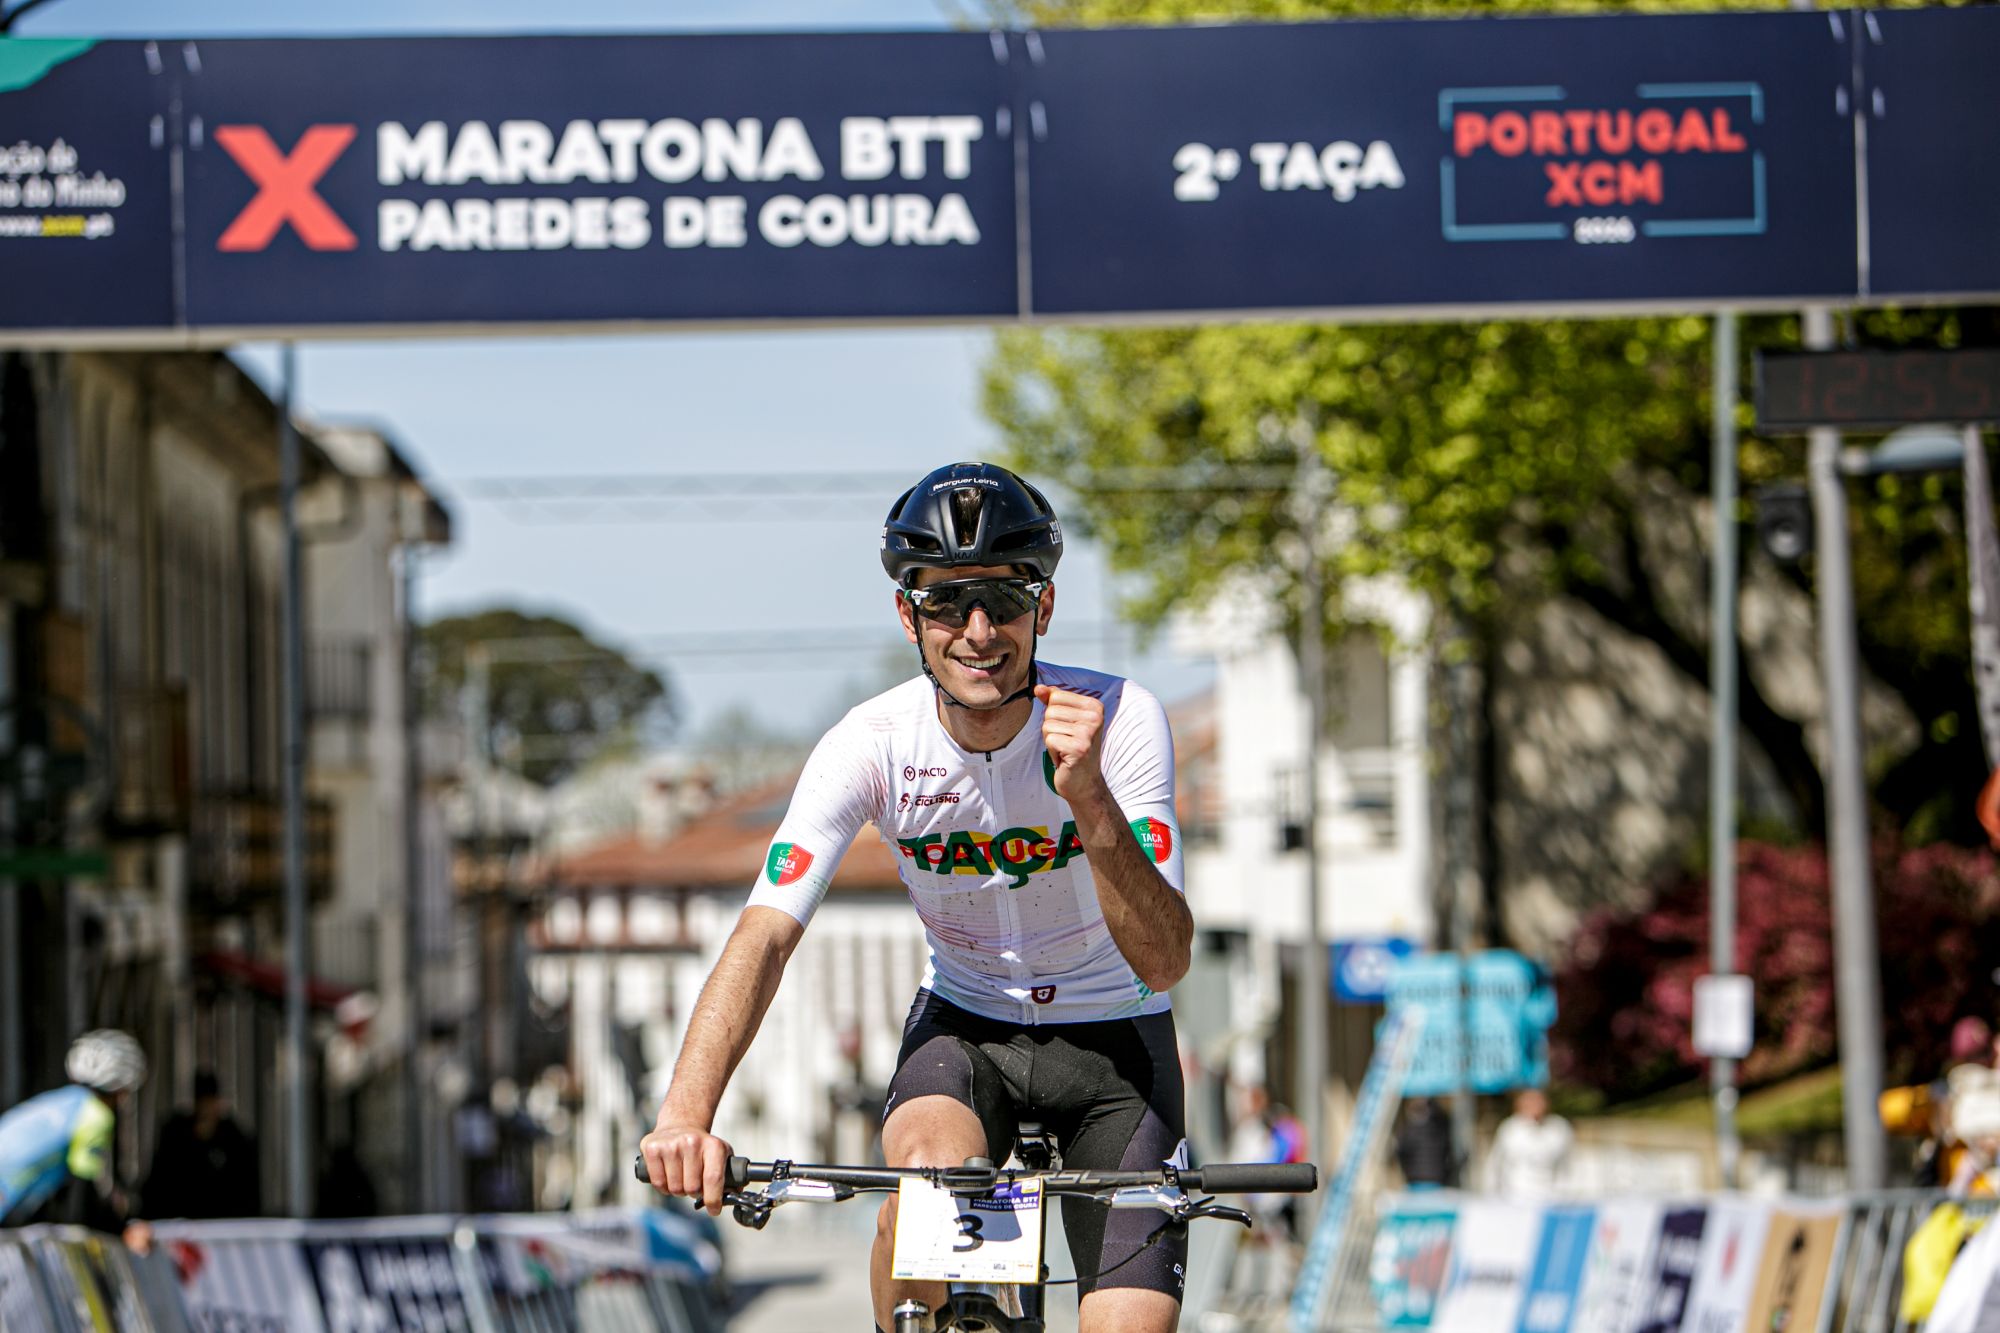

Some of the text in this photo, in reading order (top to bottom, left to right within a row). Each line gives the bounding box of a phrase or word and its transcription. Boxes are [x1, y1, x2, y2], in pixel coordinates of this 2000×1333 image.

[376, 115, 984, 186] MARATONA BTT
[1453, 107, 1747, 157] PORTUGAL
[213, 123, 360, 252] X
[1249, 140, 1406, 203] TAÇA
[1544, 159, 1663, 207] XCM
[377, 192, 981, 252] PAREDES DE COURA
[932, 477, 999, 491] Reerguer Leiria
[918, 767, 947, 778] PACTO
[915, 795, 960, 807] CICLISMO
[899, 833, 1085, 865] PORTUGA
[952, 1214, 984, 1253] 3
